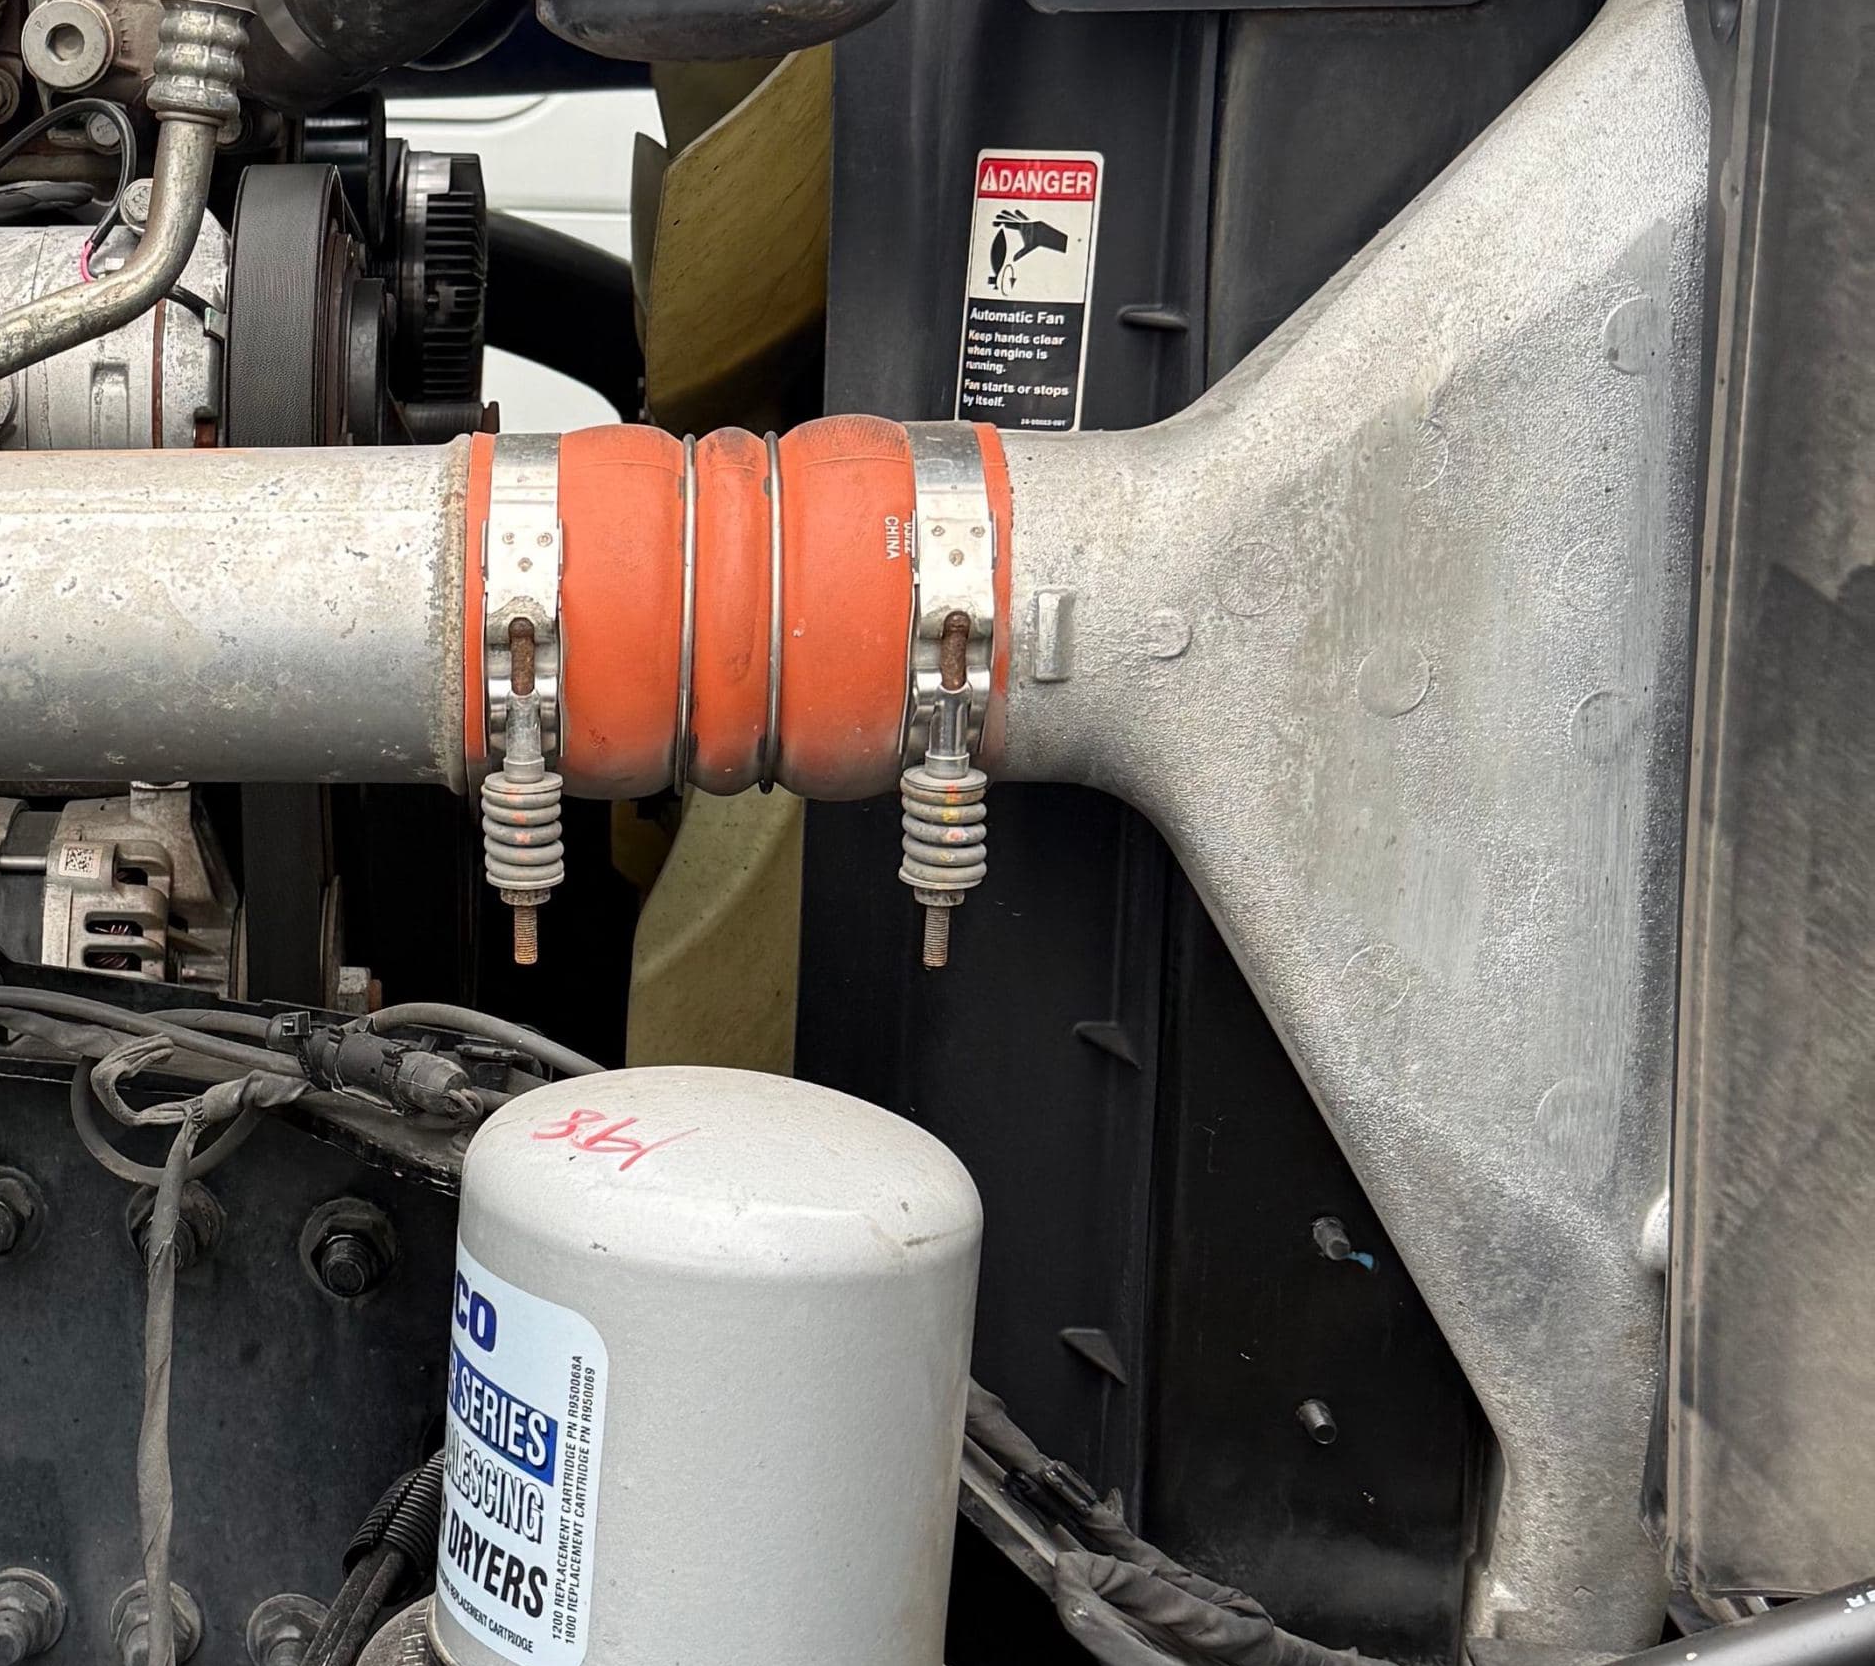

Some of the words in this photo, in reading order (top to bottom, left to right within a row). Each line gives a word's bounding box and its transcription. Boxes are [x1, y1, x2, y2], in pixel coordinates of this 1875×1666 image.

[999, 171, 1092, 195] DANGER
[970, 307, 1033, 323] Automatic
[1037, 312, 1065, 325] Fan
[968, 329, 992, 343] Keep
[994, 332, 1030, 343] hands
[1033, 334, 1066, 345] clear
[966, 361, 1006, 374] running.
[967, 345, 991, 356] when
[994, 348, 1033, 360] engine
[1037, 349, 1048, 359] is
[963, 393, 974, 406] by
[975, 394, 1005, 407] itself.
[964, 378, 980, 390] Fan
[982, 382, 1015, 392] starts
[1017, 385, 1032, 393] or
[1034, 385, 1069, 398] stops
[885, 516, 900, 560] CHINA
[568, 1355, 583, 1419] R950068A
[581, 1367, 596, 1423] R950069
[460, 1366, 548, 1467] SERIES
[566, 1422, 578, 1440] PN
[580, 1426, 591, 1444] PN
[561, 1442, 576, 1514] CARTRIDGE
[574, 1446, 590, 1518] CARTRIDGE
[448, 1508, 548, 1619] DRYERS
[554, 1515, 571, 1608] REPLACEMENT
[567, 1521, 584, 1613] REPLACEMENT
[488, 1618, 534, 1654] CARTRIDGE
[552, 1610, 564, 1640] 1200
[565, 1615, 577, 1645] 1800
